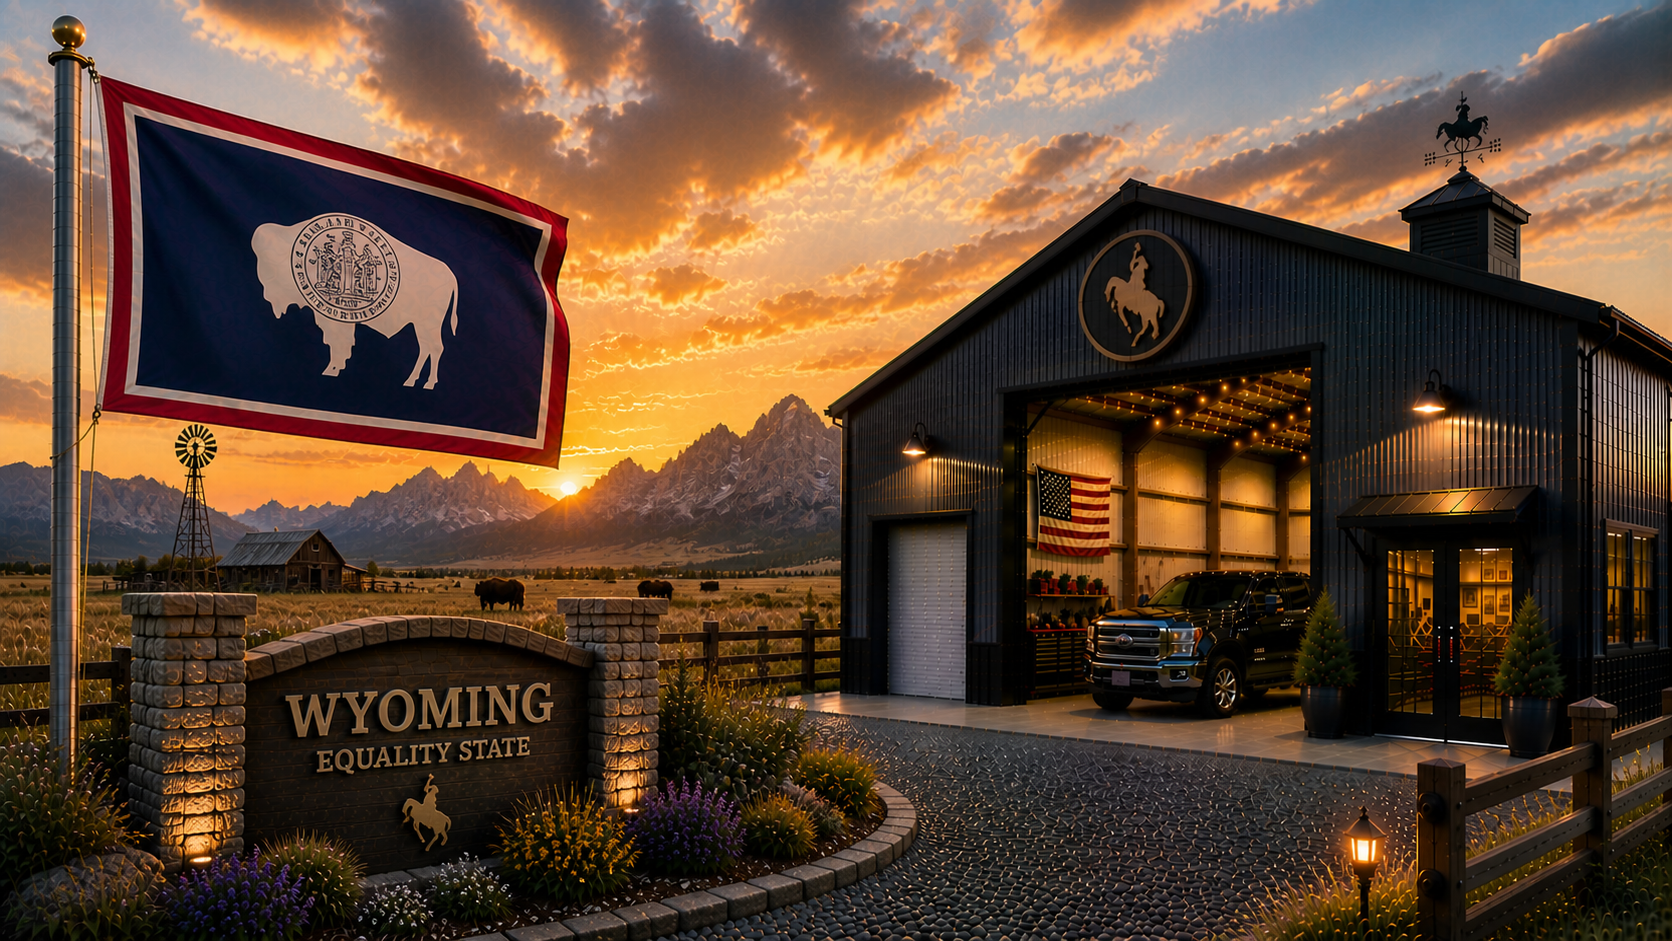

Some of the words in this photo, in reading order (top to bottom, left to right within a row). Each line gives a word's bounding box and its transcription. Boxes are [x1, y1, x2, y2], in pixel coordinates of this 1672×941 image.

[285, 682, 554, 738] WYOMING
[316, 742, 452, 775] EQUALITY
[459, 736, 531, 762] STATE
